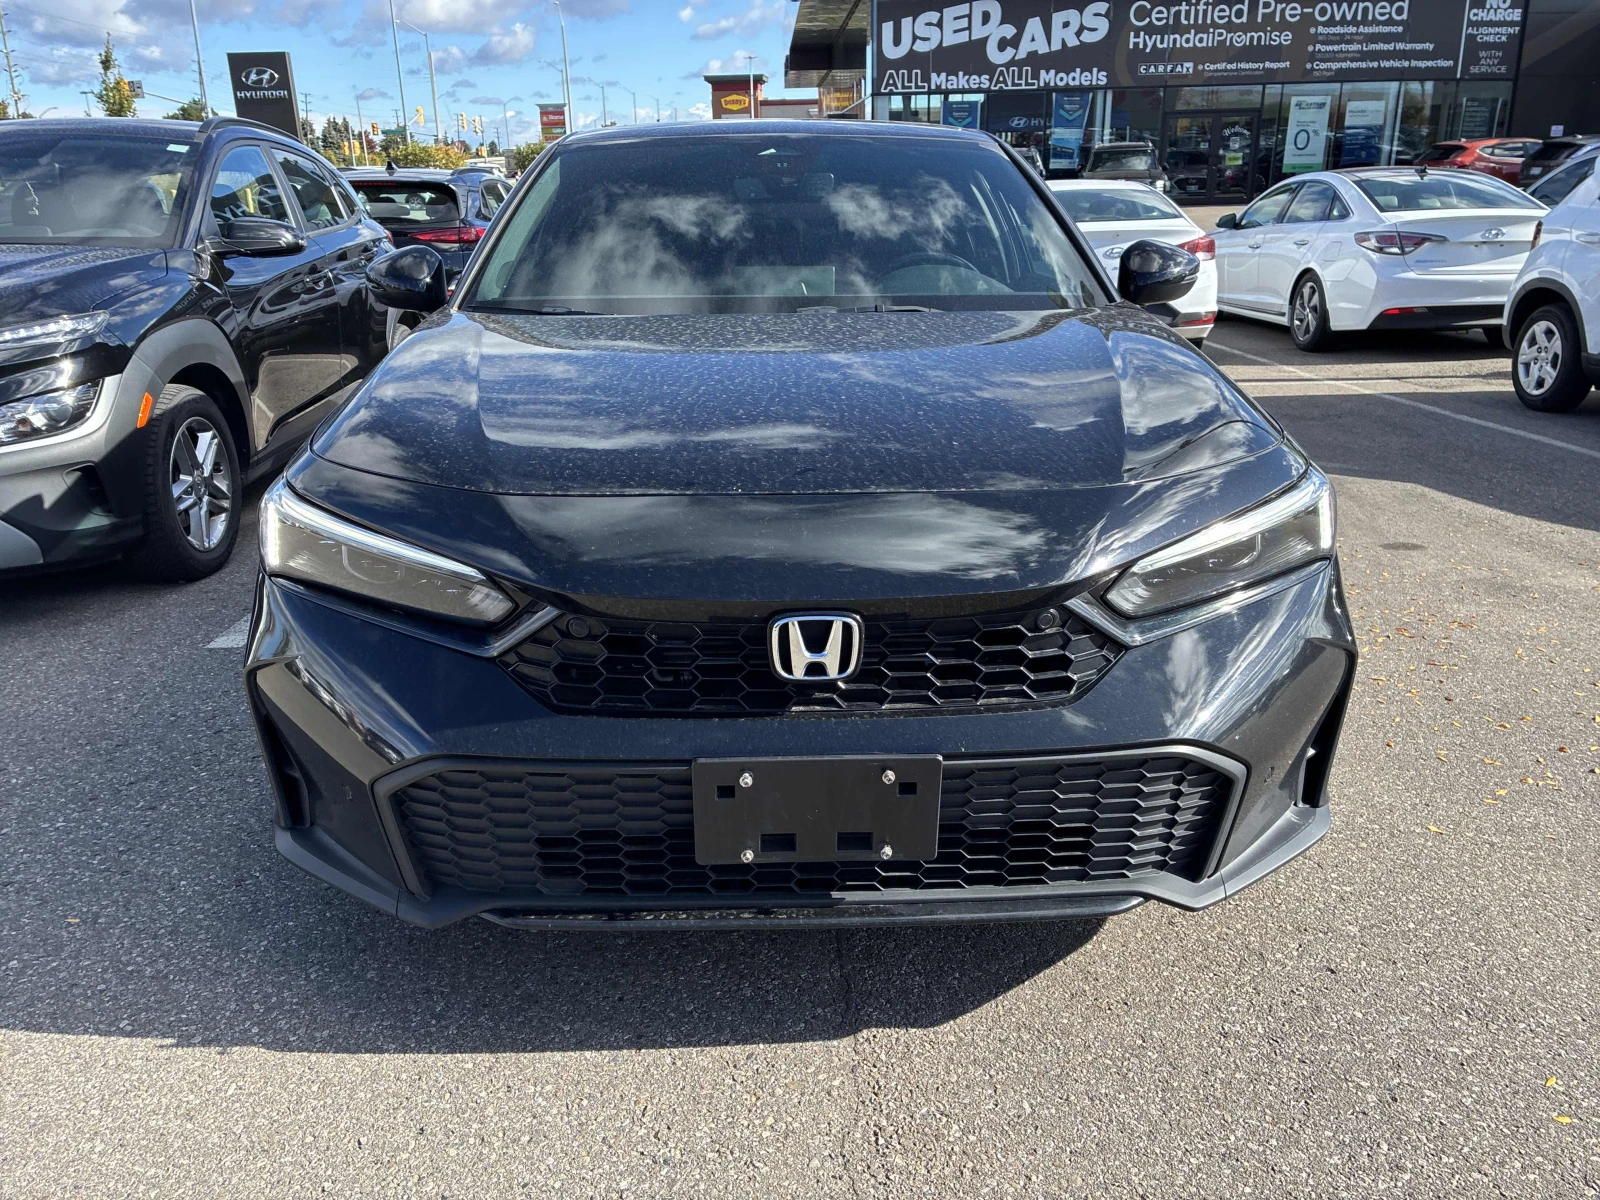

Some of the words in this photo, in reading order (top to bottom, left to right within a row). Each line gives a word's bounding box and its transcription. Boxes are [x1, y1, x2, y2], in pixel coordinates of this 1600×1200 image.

[1486, 0, 1511, 9] NO
[1129, 0, 1248, 26] Certified
[1257, 0, 1409, 23] Pre-owned
[1469, 8, 1522, 21] CHARGE
[881, 0, 1002, 59] USED
[986, 1, 1110, 65] CARS
[1317, 25, 1357, 34] Roadside
[1358, 24, 1403, 33] Assistance
[1466, 26, 1520, 34] ALIGNMENT
[1476, 34, 1508, 42] CHECK
[1315, 42, 1362, 52] Powertrain
[1362, 42, 1394, 51] Limited
[1396, 42, 1435, 51] Warranty
[1478, 50, 1503, 58] WITH
[1139, 62, 1194, 75] CARFAX
[1204, 62, 1237, 70] Certified
[1237, 61, 1264, 71] History
[1264, 60, 1291, 70] Report
[1313, 59, 1379, 70] Comprehensive
[1380, 59, 1410, 68] Vehicle
[1410, 58, 1454, 68] Inspection
[1469, 65, 1508, 73] SERVICE
[881, 70, 928, 92] ALL
[930, 71, 990, 90] Makes
[991, 67, 1038, 90] ALL
[1039, 67, 1108, 87] Models
[236, 90, 289, 99] HYUNDAI
